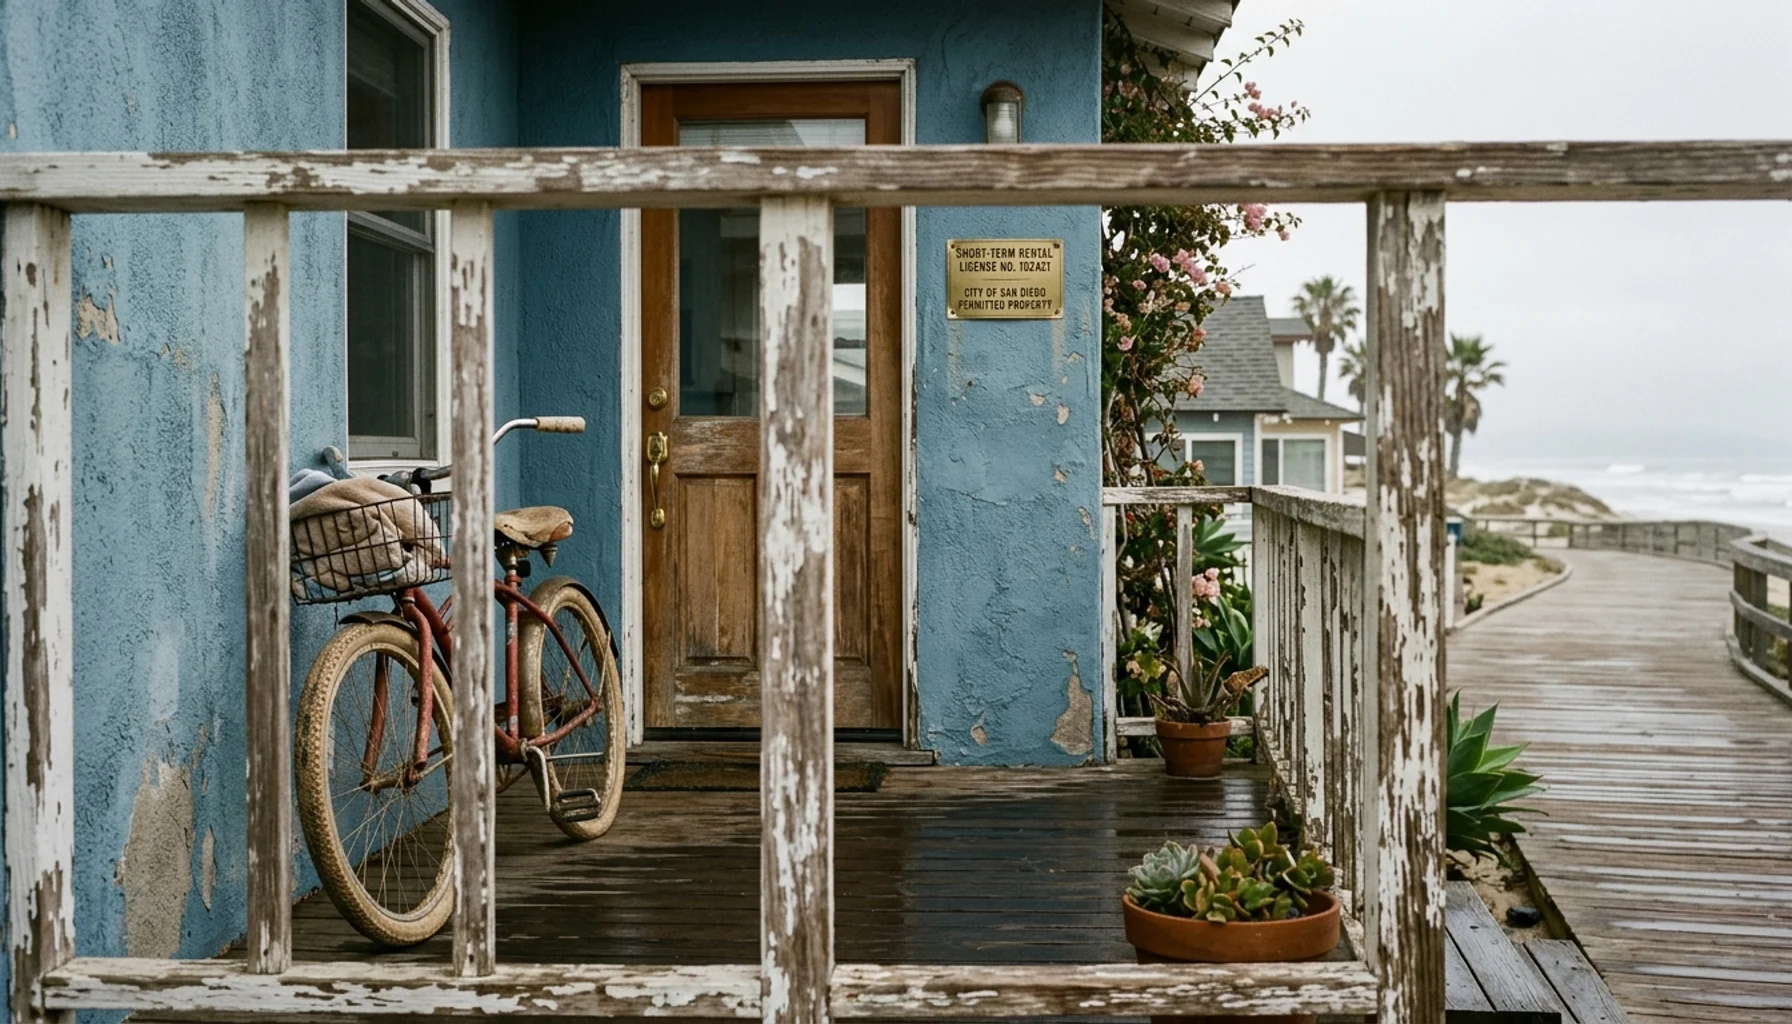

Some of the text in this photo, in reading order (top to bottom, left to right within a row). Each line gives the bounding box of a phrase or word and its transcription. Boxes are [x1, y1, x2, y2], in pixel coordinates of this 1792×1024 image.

[1000, 261, 1016, 272] NO.
[964, 287, 984, 298] CITY
[986, 287, 998, 298] OF
[1000, 287, 1018, 298] SAN
